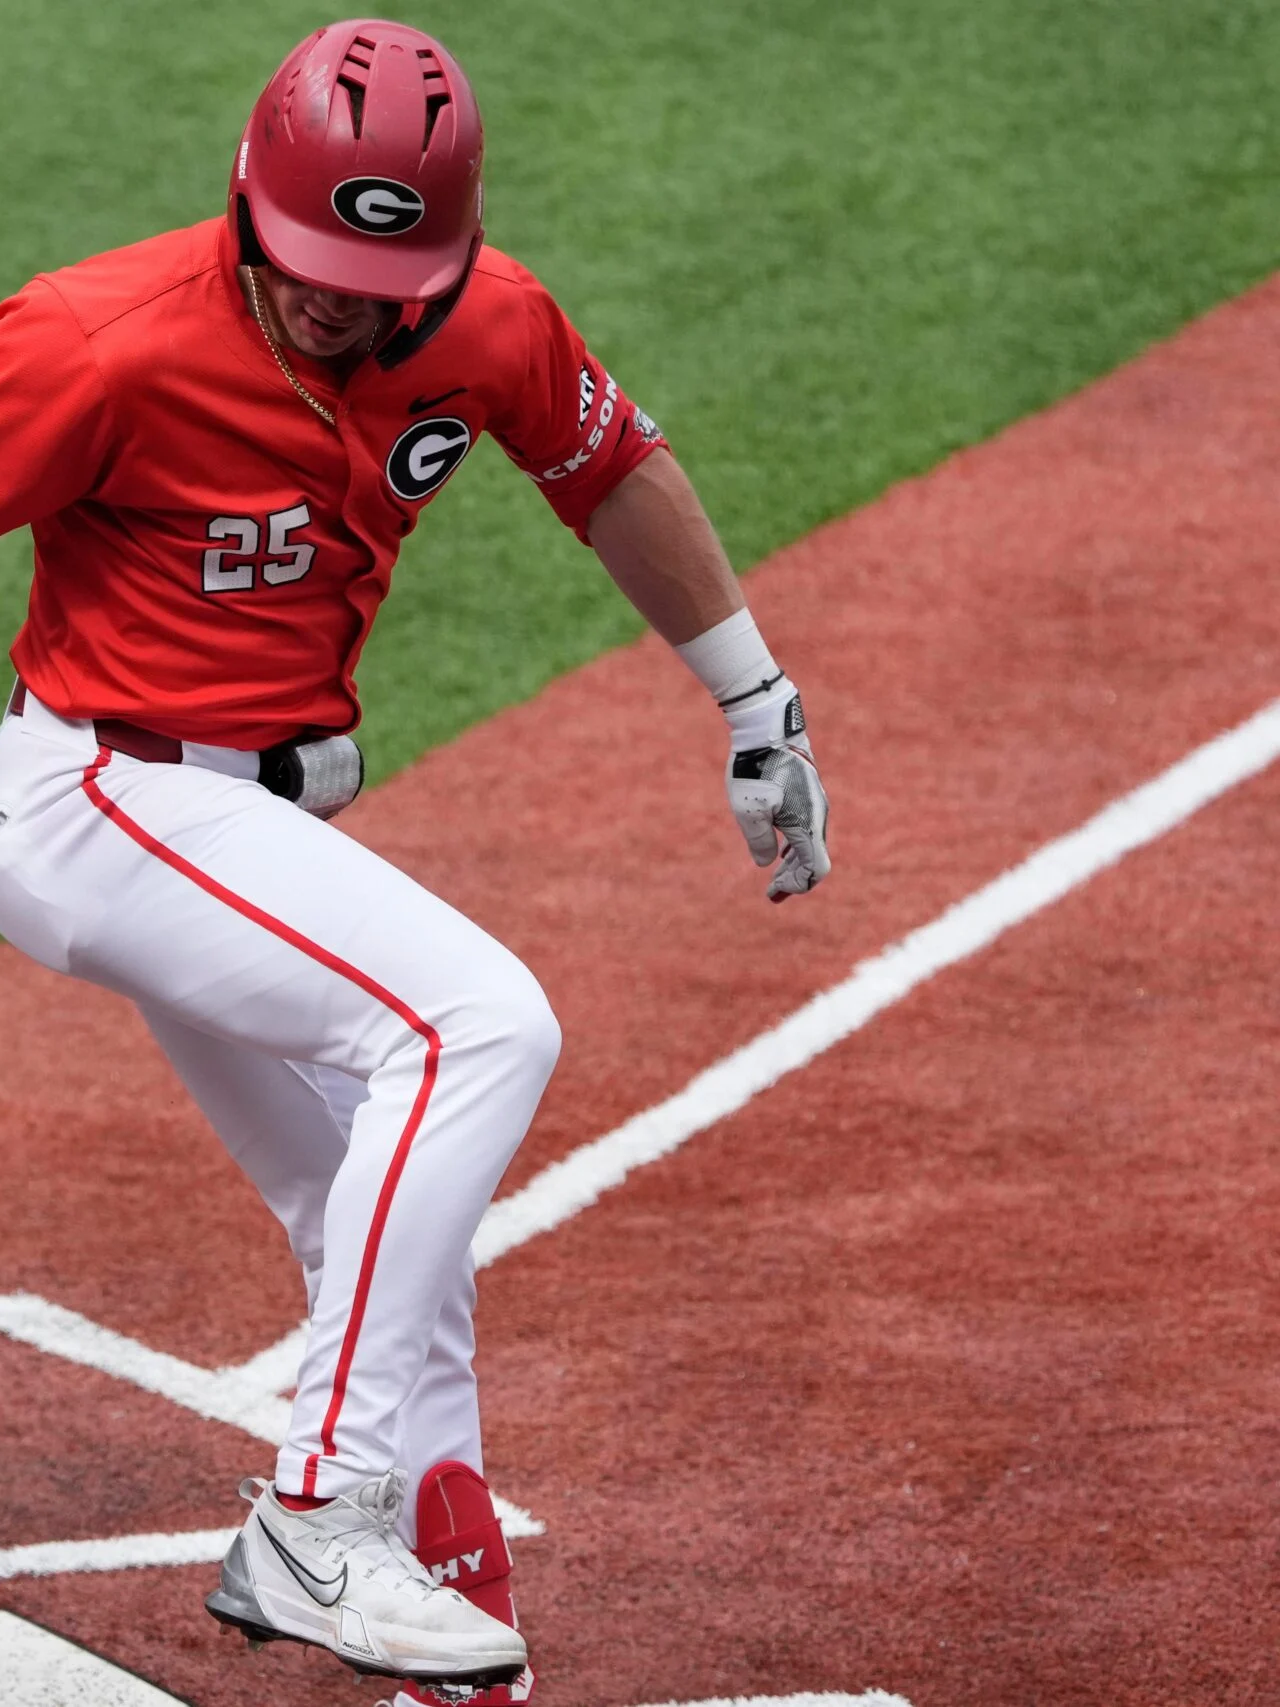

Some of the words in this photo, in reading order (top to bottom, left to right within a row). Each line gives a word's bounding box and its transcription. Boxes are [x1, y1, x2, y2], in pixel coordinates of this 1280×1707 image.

[238, 141, 249, 179] marucci
[331, 176, 425, 235] G
[386, 417, 470, 499] G
[526, 371, 617, 482] CKSON
[202, 503, 316, 594] 25
